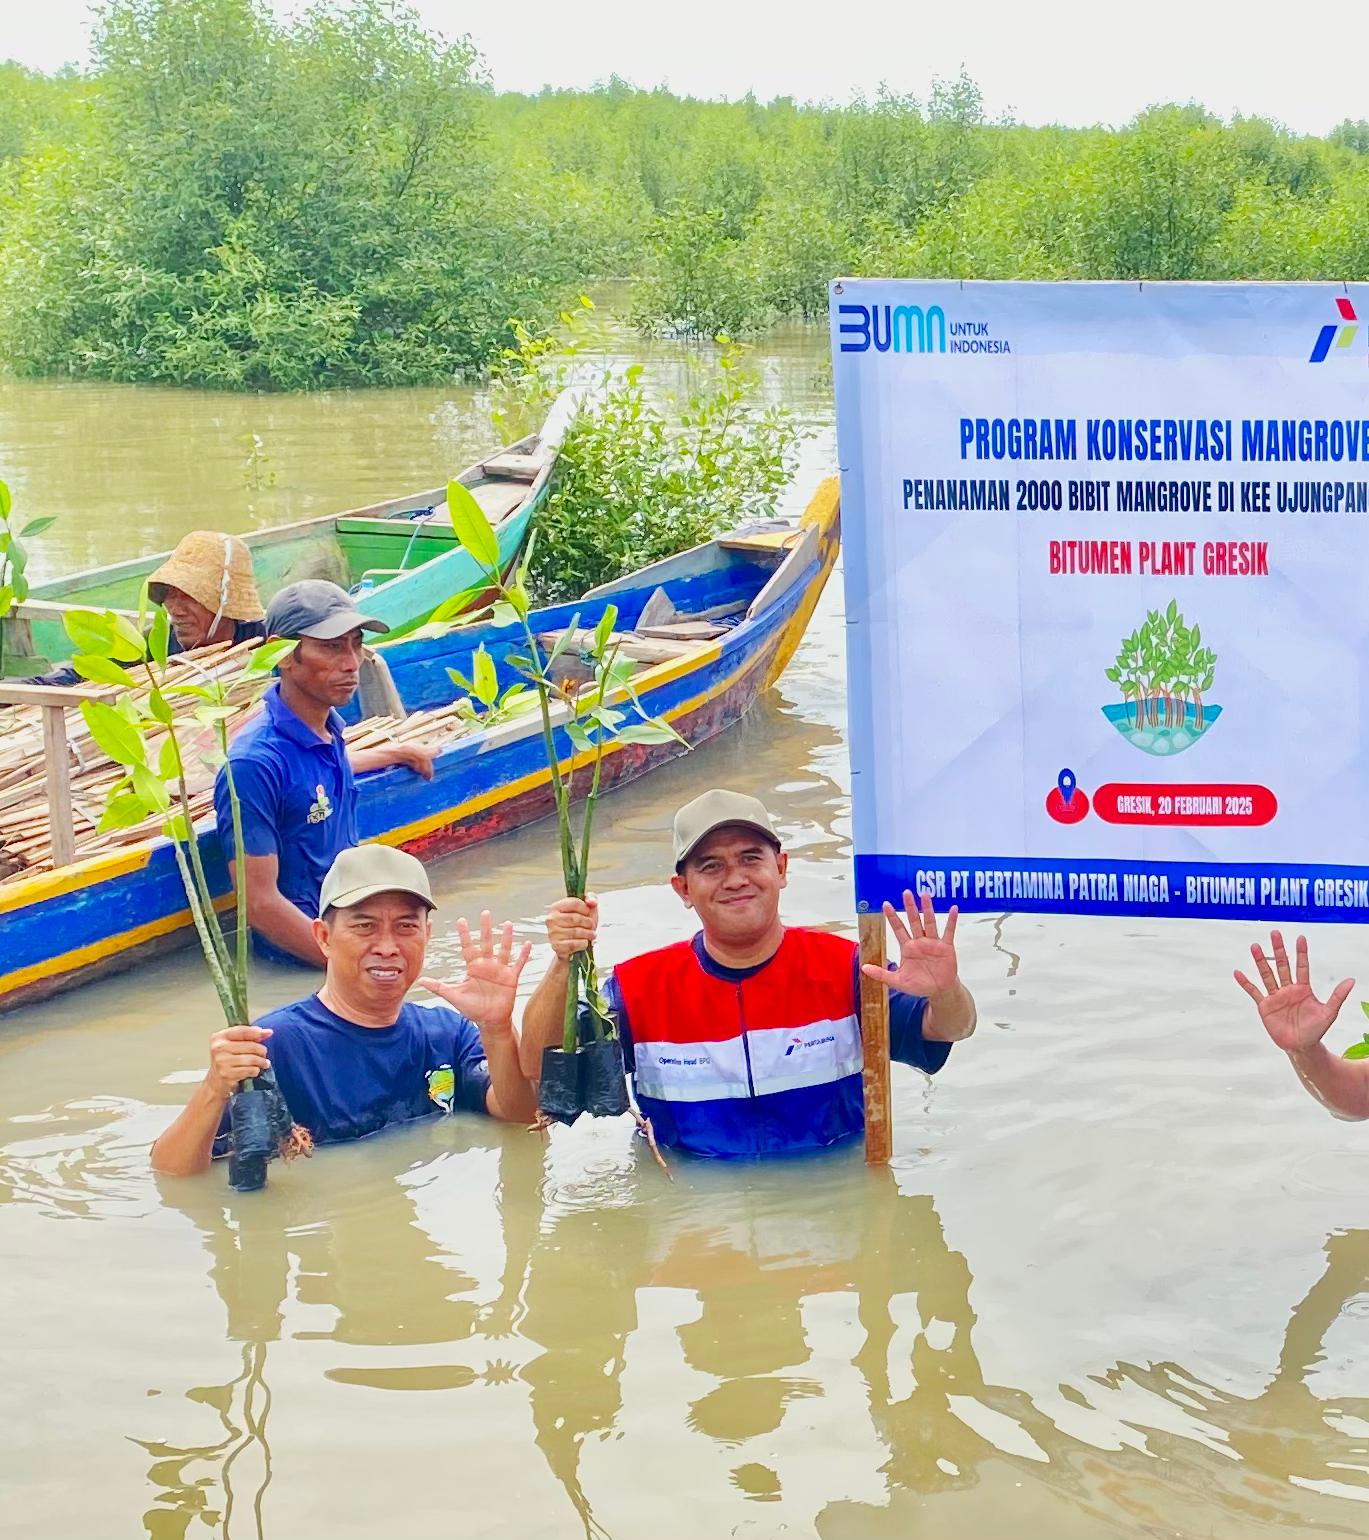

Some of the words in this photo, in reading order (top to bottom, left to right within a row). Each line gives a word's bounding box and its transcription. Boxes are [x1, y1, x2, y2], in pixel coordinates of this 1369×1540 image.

[950, 322, 989, 336] UNTUK
[950, 340, 1011, 354] INDONESIA
[960, 418, 1077, 460] PROGRAM
[1087, 419, 1232, 461] KONSERVASI
[903, 479, 1010, 511] PENANAMAN
[1016, 480, 1062, 511] 2000
[1068, 480, 1110, 511] BIBIT
[1116, 481, 1212, 512] MANGROVE
[1218, 481, 1234, 512] DI
[1241, 481, 1271, 513] KEE
[1049, 541, 1131, 574] BITUMEN
[1139, 542, 1196, 575] PLANT
[1203, 542, 1268, 576] GRESIK
[1117, 795, 1155, 816] GRESIK,
[1158, 796, 1172, 815] 20
[1174, 796, 1222, 815] FEBRUARI
[1225, 797, 1252, 815] 2025
[916, 870, 946, 898] CSR
[951, 870, 969, 898] PT
[975, 870, 1064, 900] PERTAMINA
[1069, 873, 1118, 902] PATRA
[1123, 874, 1169, 902] NIAGA
[1186, 876, 1255, 905] BITUMEN
[1261, 878, 1309, 906] PLANT
[1314, 879, 1369, 908] GRESIK
